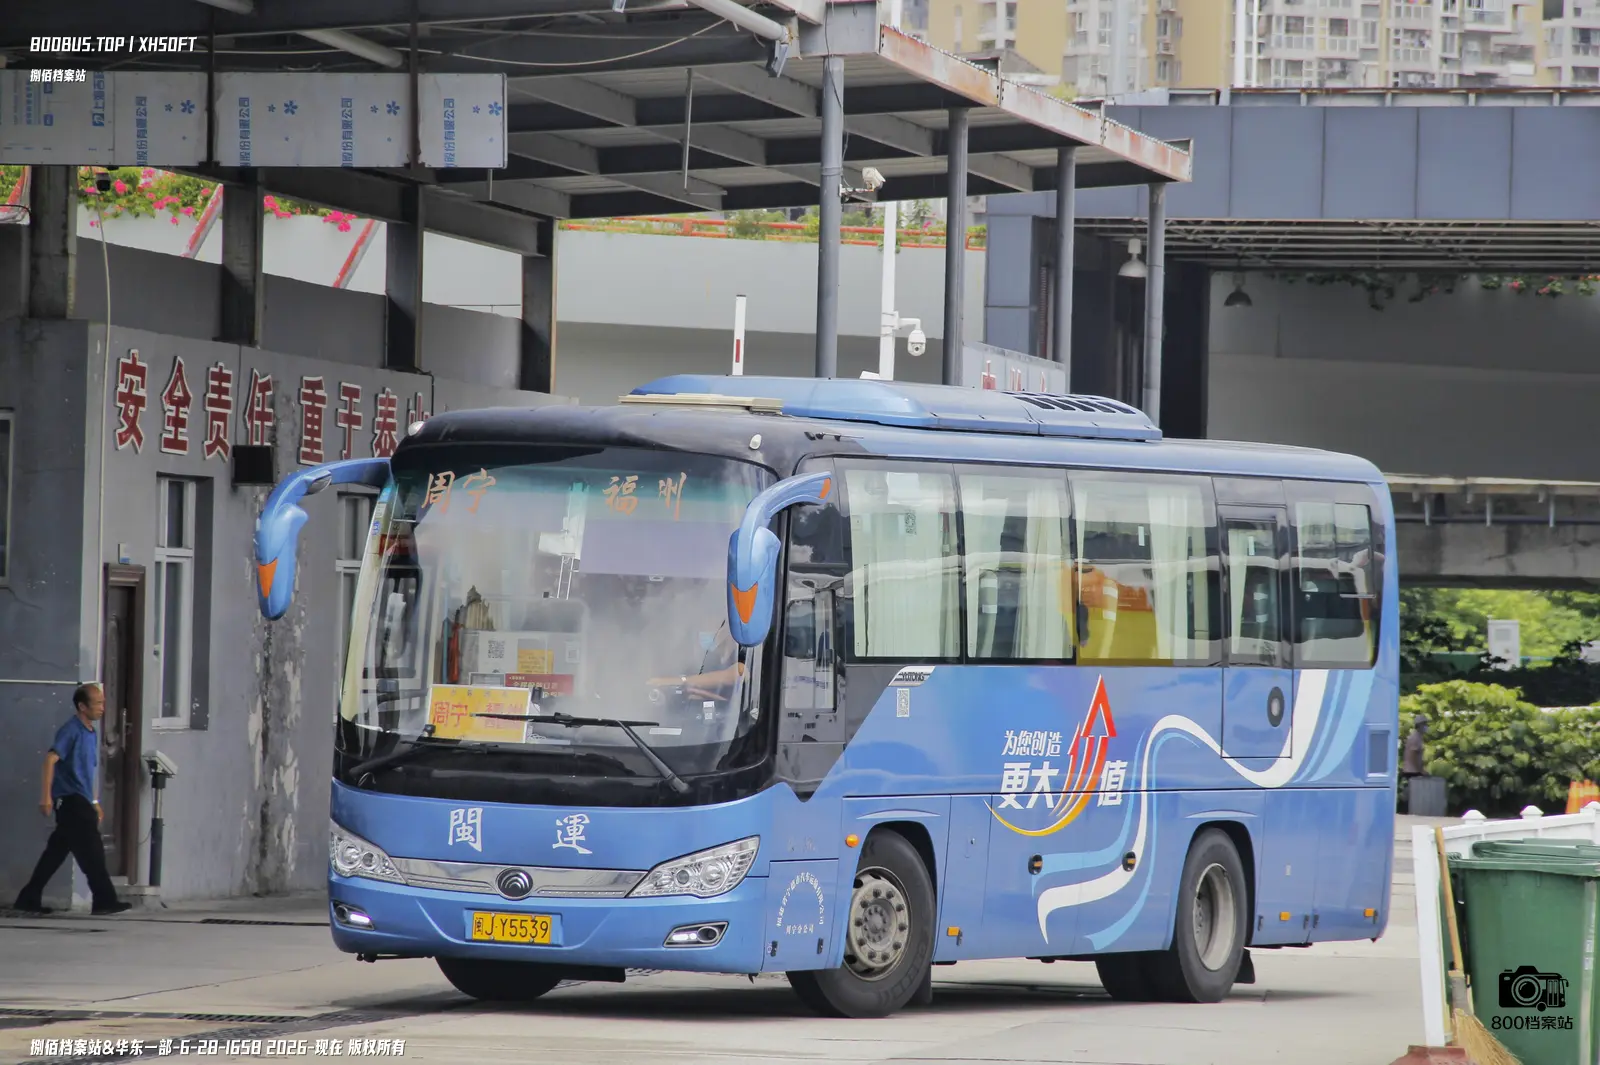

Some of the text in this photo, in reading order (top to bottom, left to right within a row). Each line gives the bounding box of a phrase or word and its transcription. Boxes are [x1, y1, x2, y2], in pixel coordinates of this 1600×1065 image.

[602, 472, 687, 521] 福州
[1001, 730, 1063, 757] 为您创造
